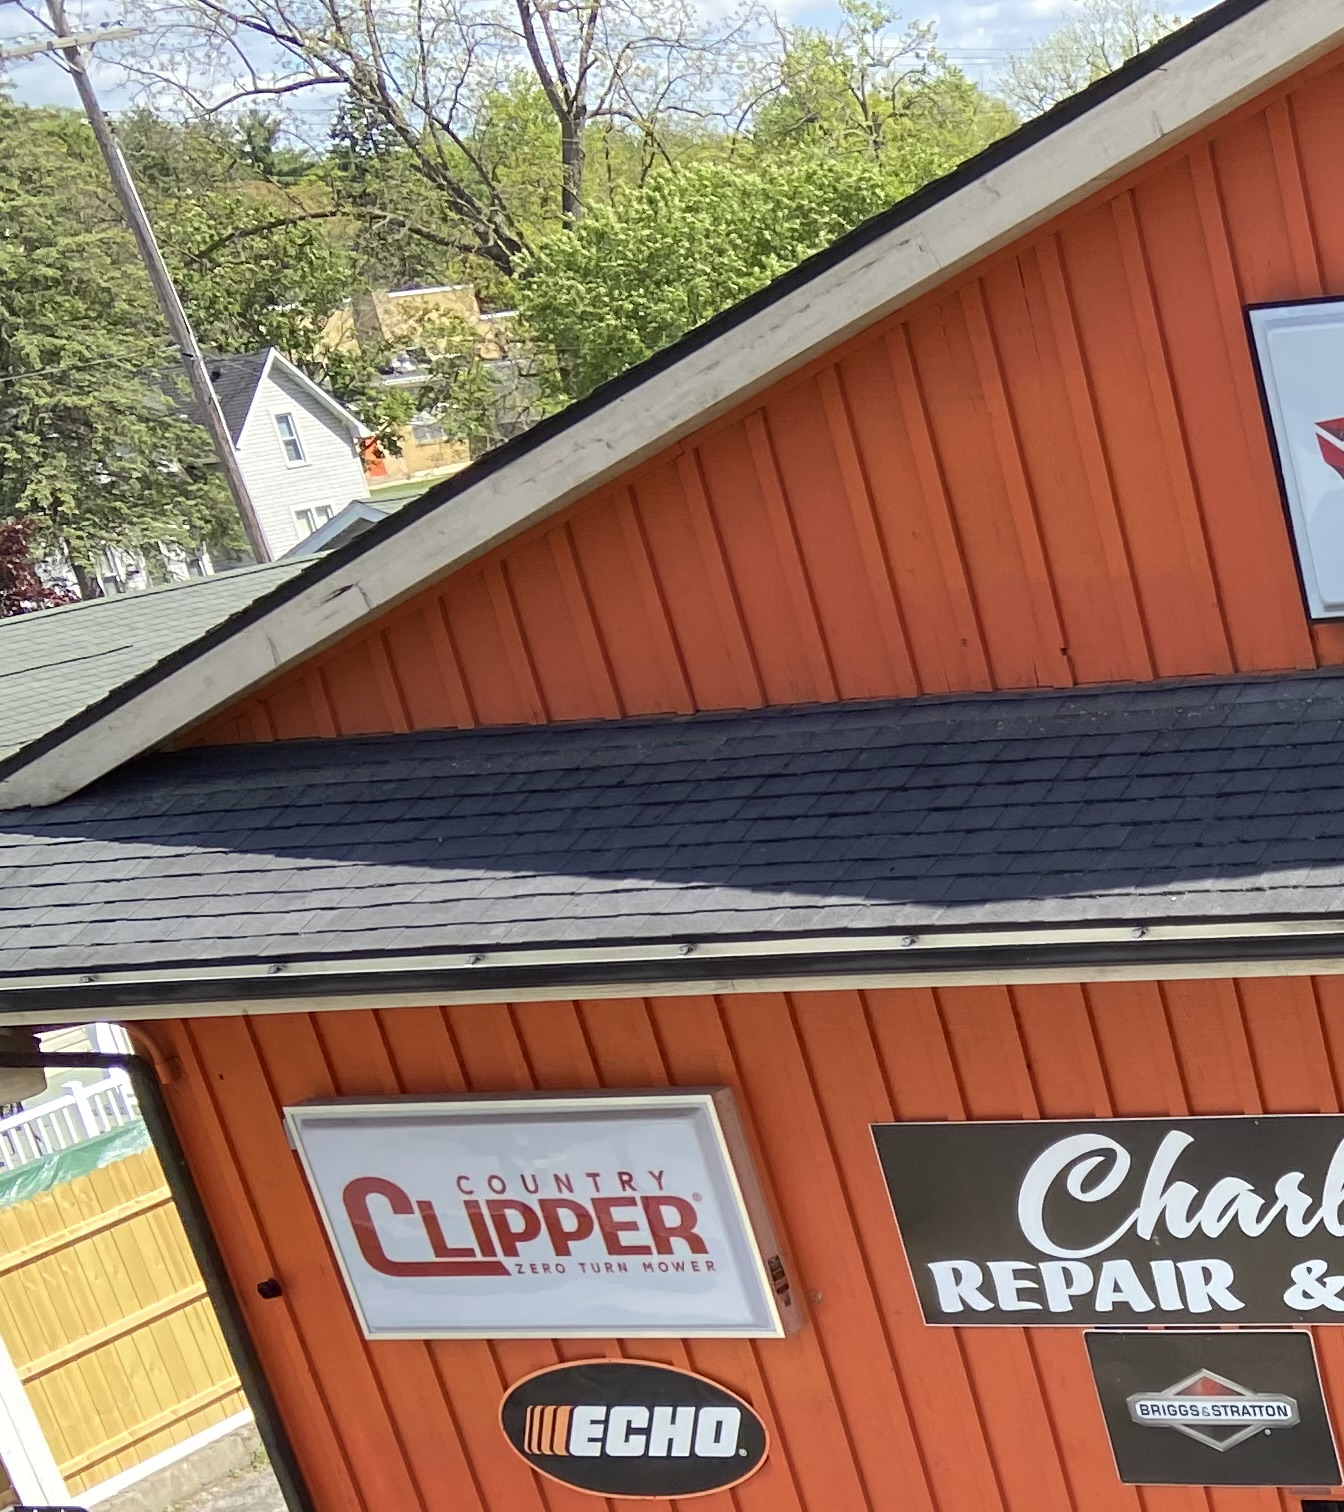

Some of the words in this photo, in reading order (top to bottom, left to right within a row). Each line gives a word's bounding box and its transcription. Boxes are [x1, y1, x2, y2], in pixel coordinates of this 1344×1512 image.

[456, 1170, 665, 1195] COUNTRY
[342, 1176, 710, 1277] CLIPPER
[515, 1262, 566, 1275] ZERO
[578, 1261, 628, 1274] TURN
[643, 1260, 717, 1274] MOWER
[928, 1257, 1245, 1314] REPAIR
[569, 1404, 742, 1458] ECHO
